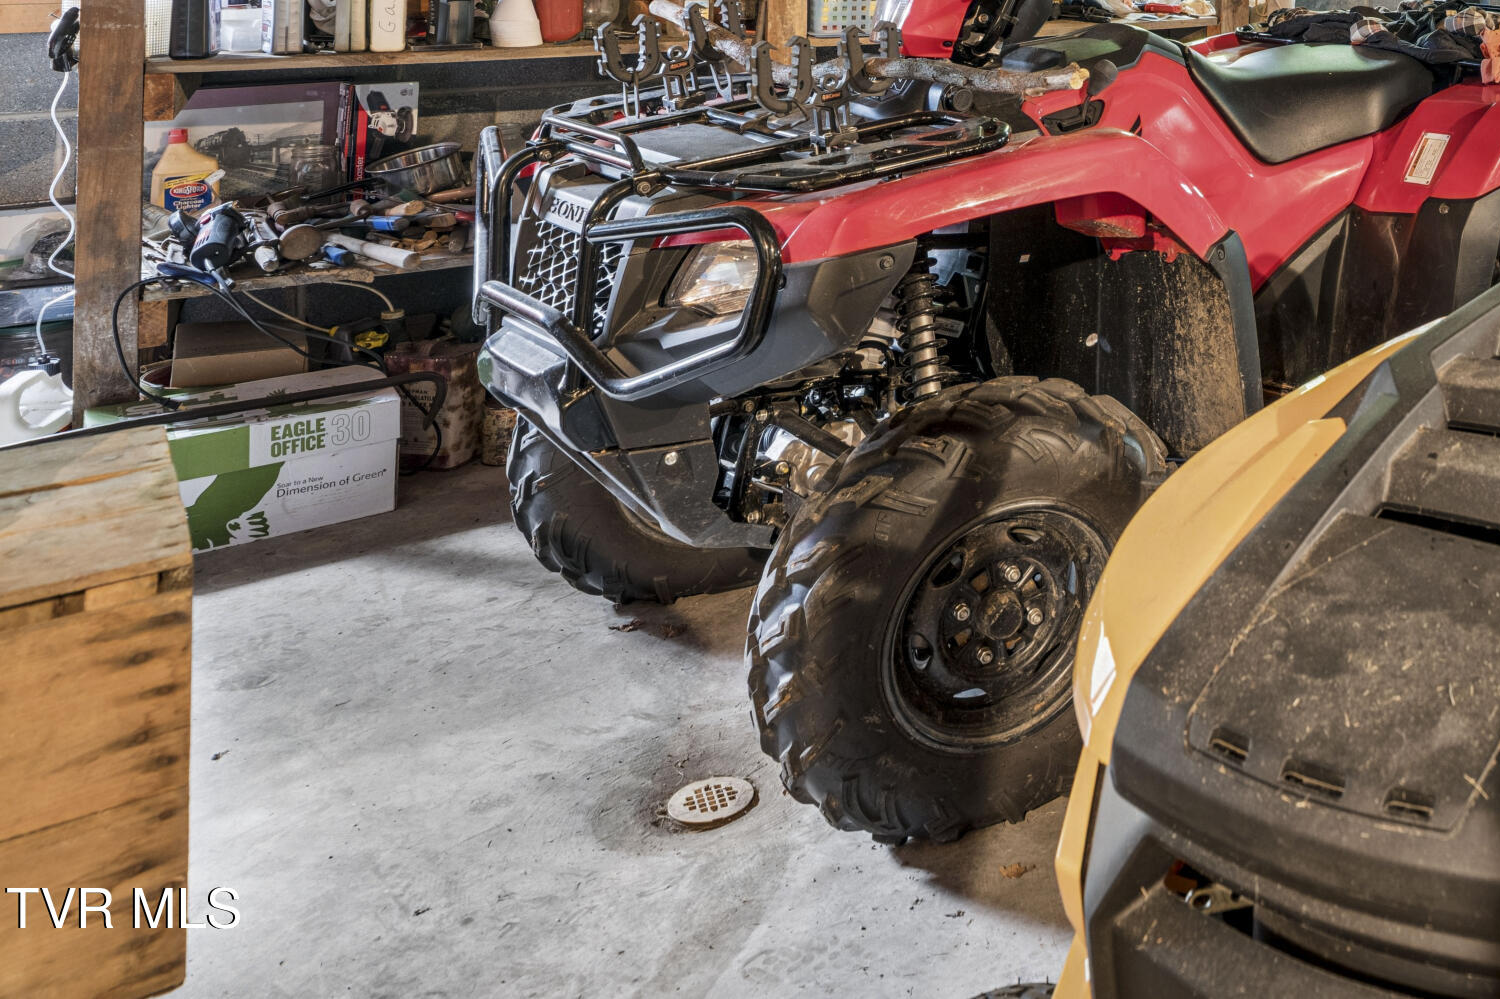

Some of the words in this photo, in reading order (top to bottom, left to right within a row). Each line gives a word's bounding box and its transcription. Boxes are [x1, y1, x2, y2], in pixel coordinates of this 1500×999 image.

[270, 417, 326, 441] EAGLE
[331, 410, 371, 445] 30
[270, 433, 326, 458] OFFICE
[276, 481, 336, 498] Dimension
[339, 475, 350, 486] of
[353, 470, 384, 482] Green
[277, 481, 292, 489] Soar
